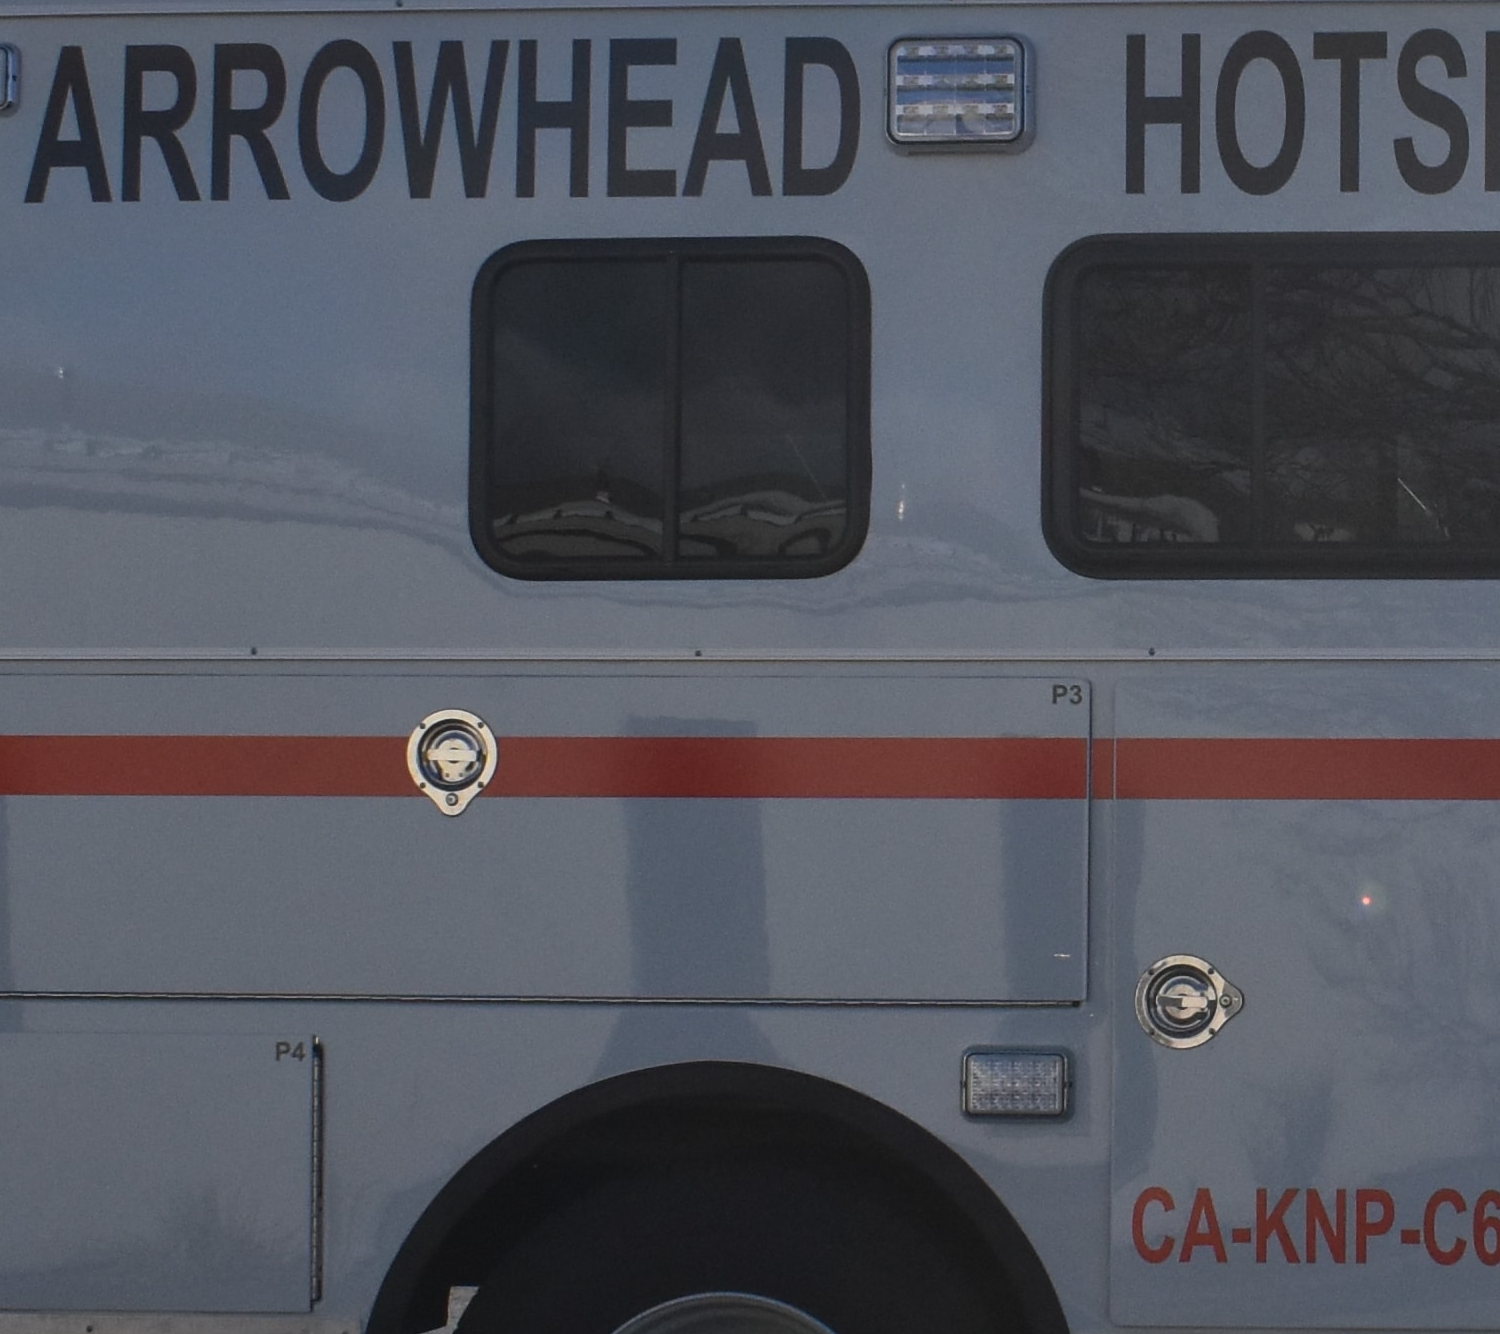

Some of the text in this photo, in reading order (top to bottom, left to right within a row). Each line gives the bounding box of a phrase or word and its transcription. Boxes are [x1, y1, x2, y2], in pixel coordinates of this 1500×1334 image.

[23, 35, 862, 203] ARROWHEAD
[1052, 684, 1083, 705] P3
[275, 1041, 306, 1062] P4
